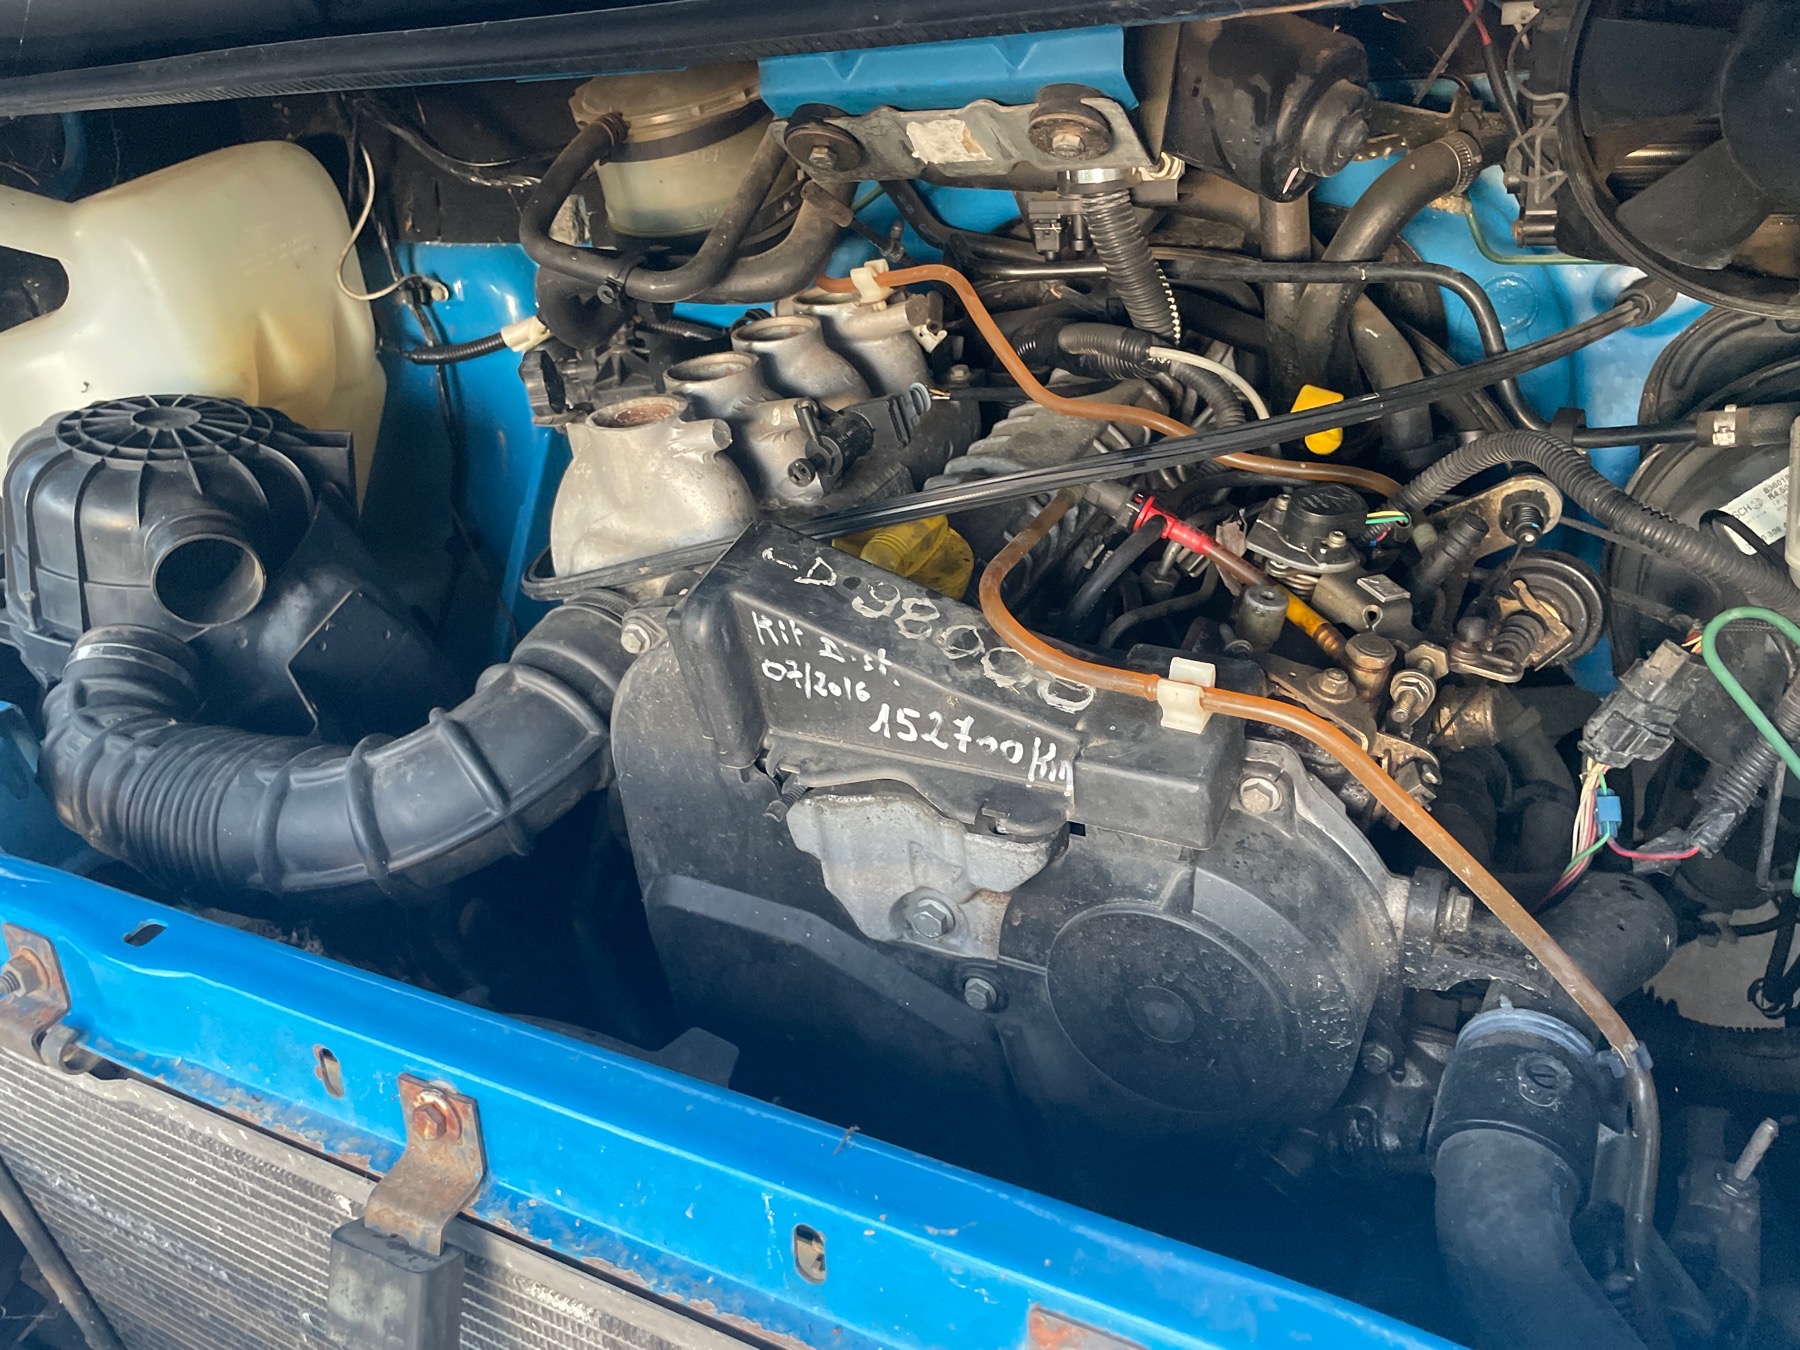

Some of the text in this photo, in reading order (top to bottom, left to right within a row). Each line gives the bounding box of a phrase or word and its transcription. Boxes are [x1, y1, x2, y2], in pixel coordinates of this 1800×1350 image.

[1732, 503, 1752, 519] SCH
[752, 610, 803, 647] Kit
[761, 658, 871, 702] 07/2016
